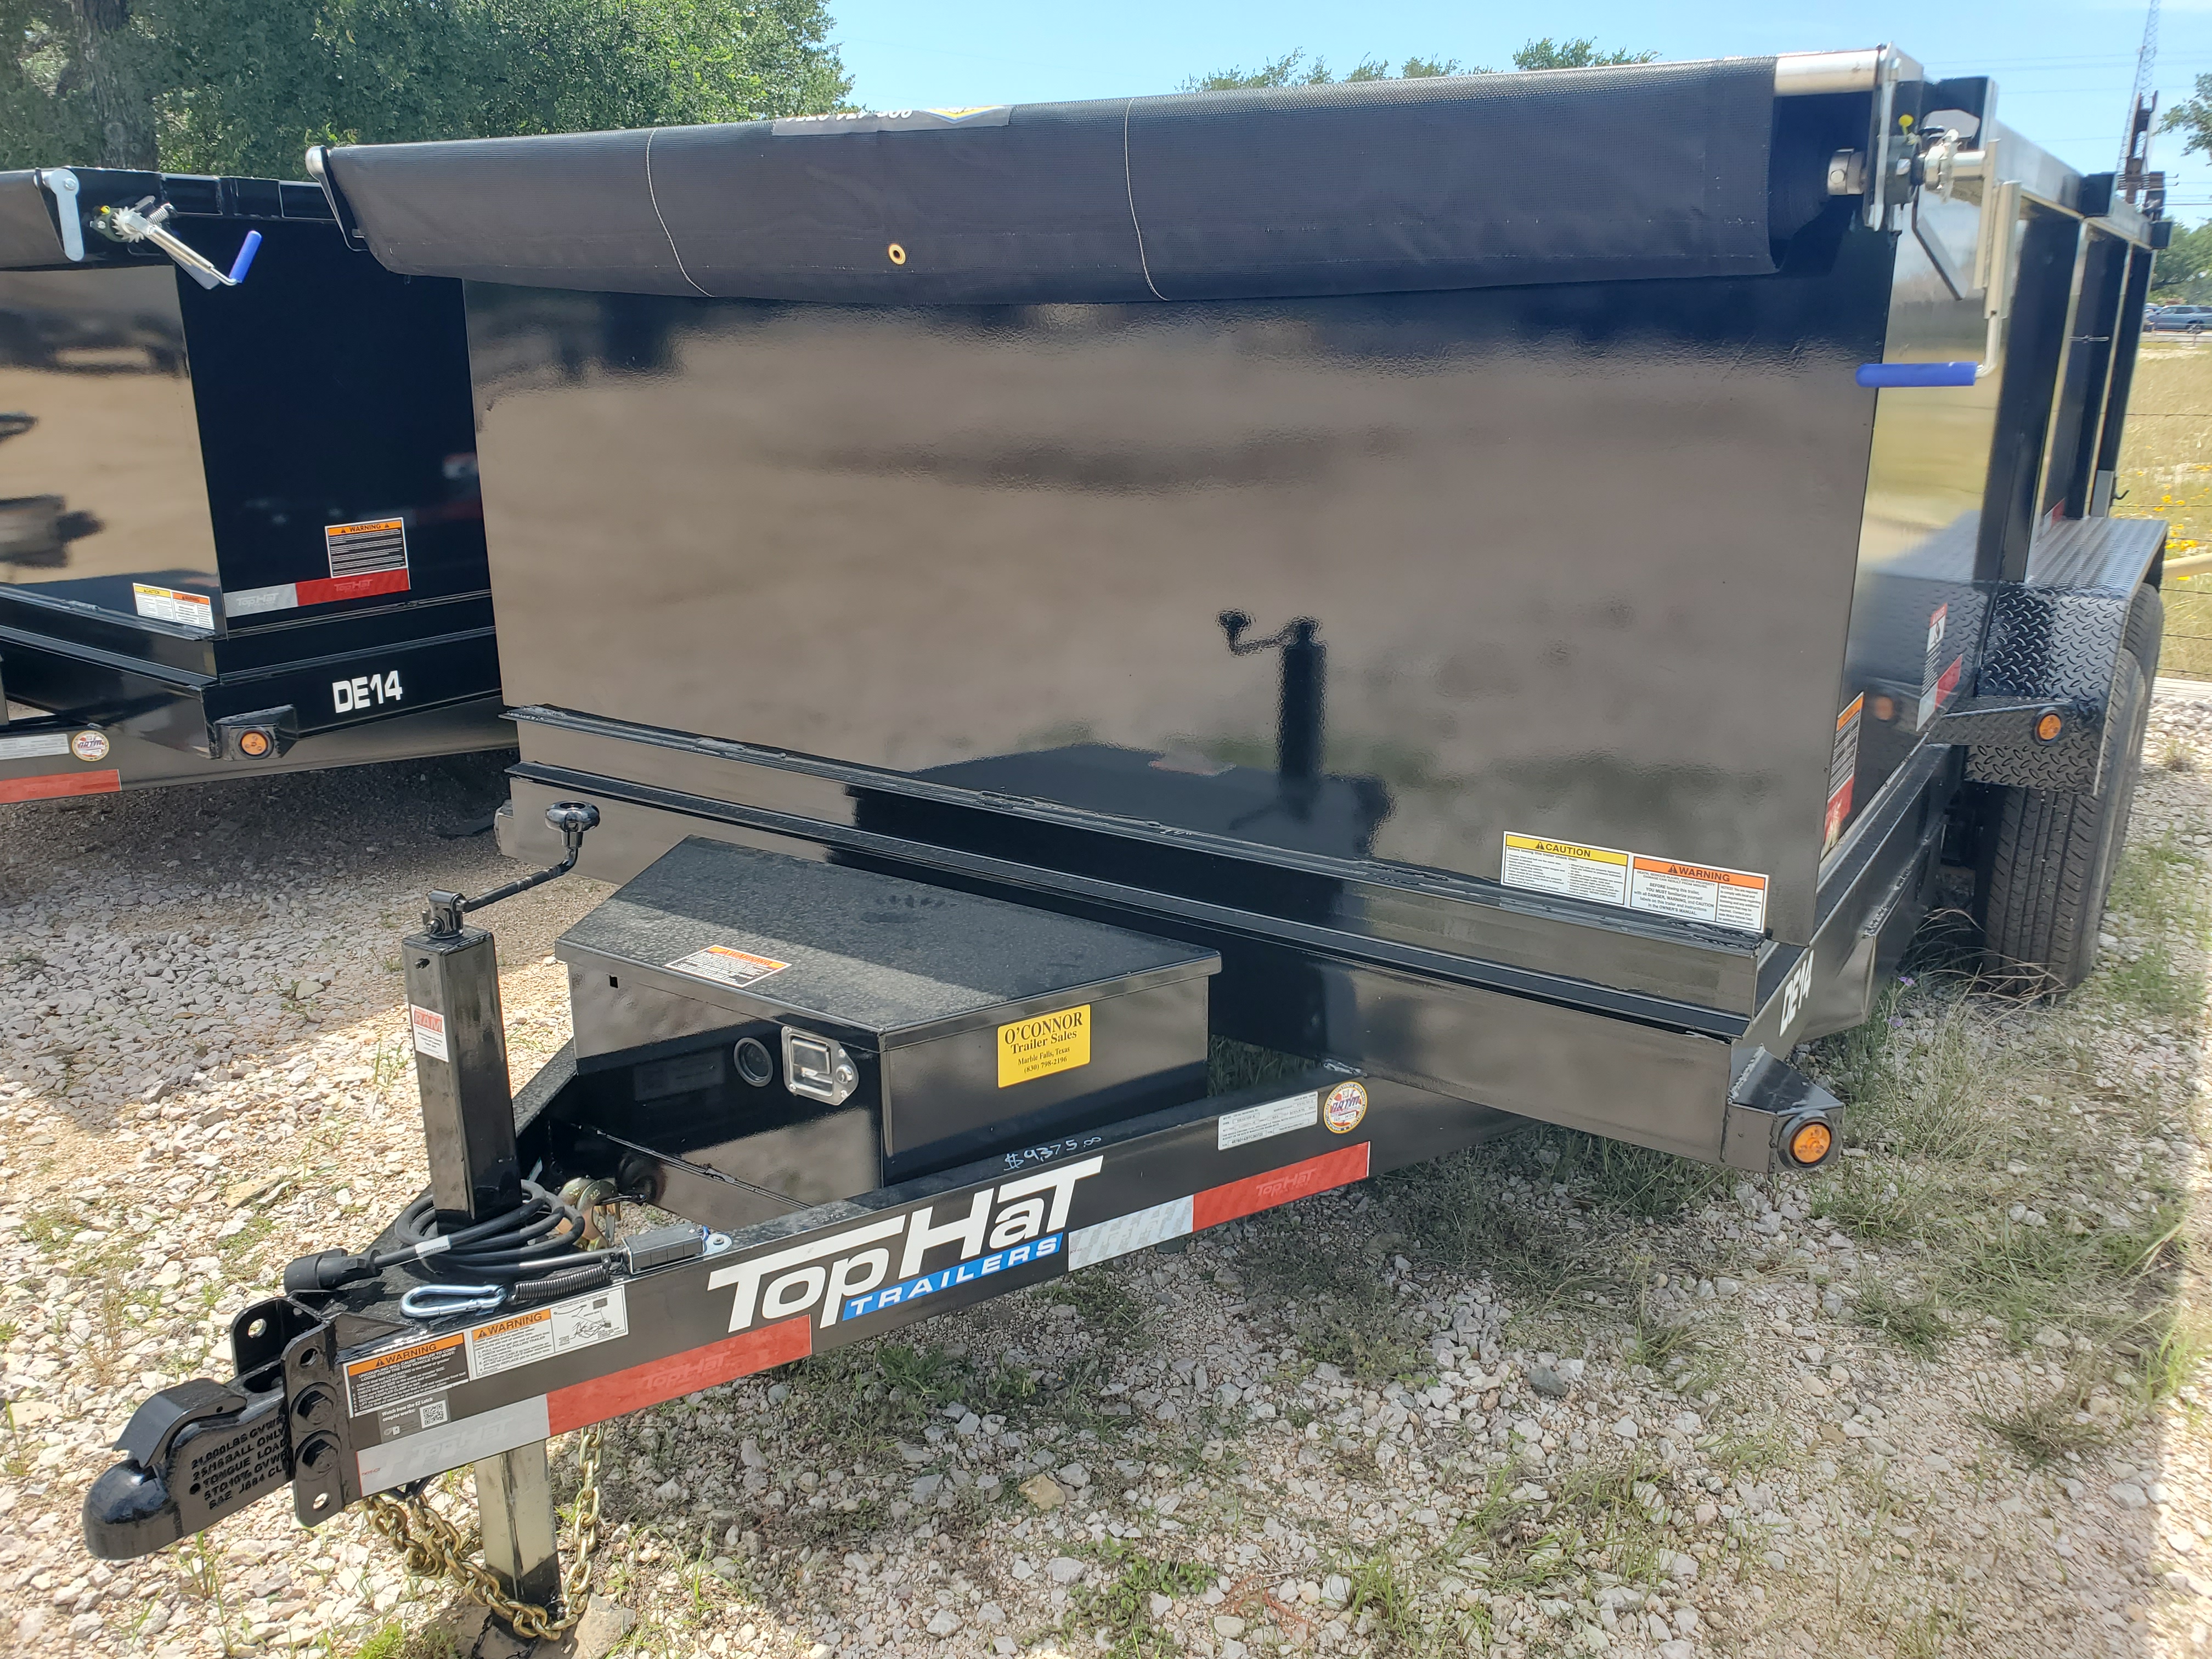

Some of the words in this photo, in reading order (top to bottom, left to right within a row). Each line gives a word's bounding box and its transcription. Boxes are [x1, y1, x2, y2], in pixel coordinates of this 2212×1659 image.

[349, 524, 381, 532] WARNING
[332, 670, 403, 713] DE14
[1545, 843, 1590, 857] CAUTION
[1679, 866, 1730, 882] WARNING
[731, 950, 773, 966] WARNING
[1779, 949, 1814, 1037] DE14
[416, 1012, 442, 1033] RAM
[1005, 1011, 1082, 1045] O'CONNOR
[1011, 1035, 1047, 1054] Trailer
[1051, 1028, 1076, 1043] Sales
[1018, 1053, 1037, 1065] Marble
[1040, 1049, 1053, 1060] Falls,
[1055, 1045, 1070, 1055] Texas
[1024, 1063, 1039, 1074] (830)
[851, 1237, 1058, 1316] TRAILERS
[487, 1312, 541, 1335] WARNING
[385, 1343, 436, 1363] WARNING
[412, 1358, 430, 1366] VEHICLE
[416, 1352, 435, 1361] TRAILER
[381, 1408, 396, 1416] Watch
[382, 1413, 399, 1422] coupler
[400, 1408, 415, 1416] works:
[203, 1458, 251, 1488] TONGUE
[208, 1491, 233, 1510] SAE
